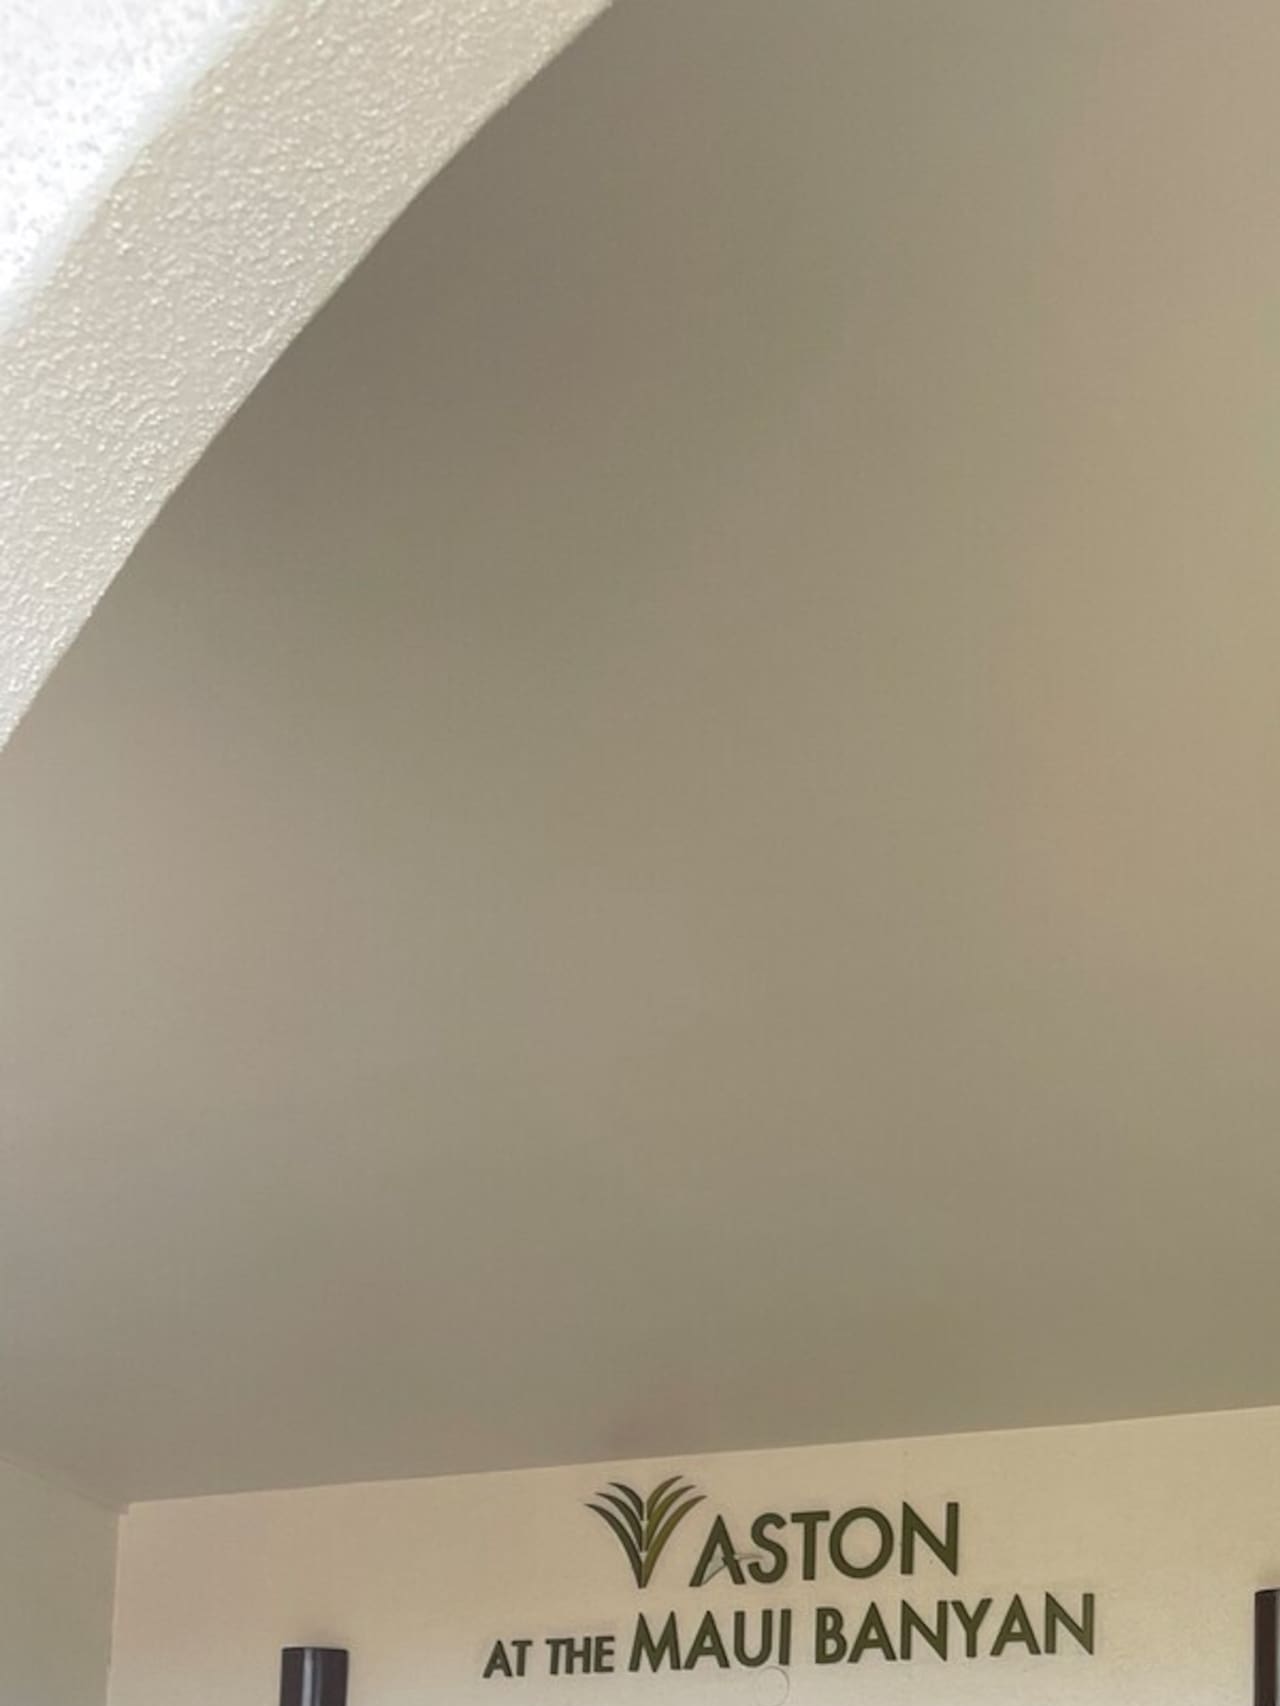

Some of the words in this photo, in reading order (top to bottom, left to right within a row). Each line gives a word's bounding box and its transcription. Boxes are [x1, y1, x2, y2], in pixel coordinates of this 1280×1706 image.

[689, 1502, 959, 1587] ASTON
[483, 1640, 533, 1678] AT
[546, 1636, 615, 1676] THE
[628, 1609, 792, 1673] MAUI
[815, 1592, 1095, 1665] BANYAN
